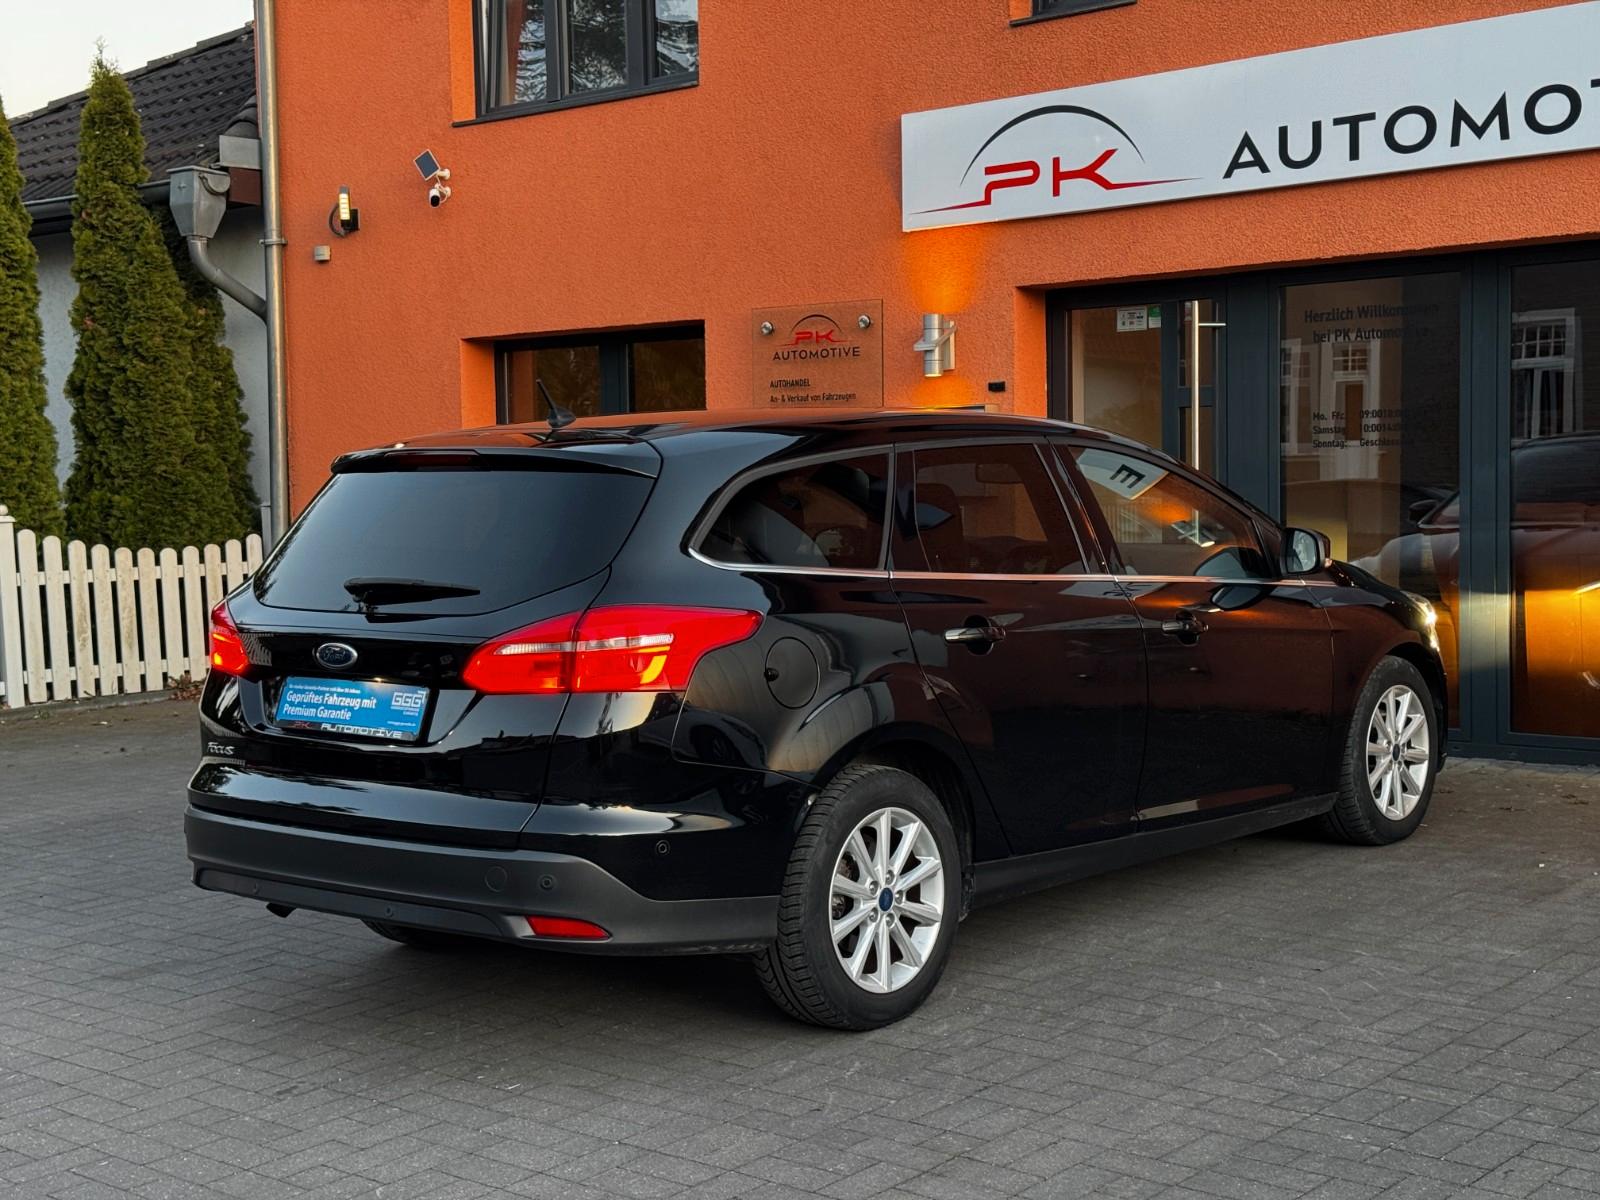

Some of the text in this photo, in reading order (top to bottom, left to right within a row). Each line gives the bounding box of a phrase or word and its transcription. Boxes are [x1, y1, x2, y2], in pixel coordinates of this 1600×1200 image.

[1304, 303, 1439, 323] Herzlich Willkom
[793, 329, 836, 346] PK
[1312, 330, 1331, 343] bei
[1334, 328, 1351, 342] PK
[772, 346, 861, 361] AUTOMOTIVE
[769, 378, 811, 389] AUTOHANDEL
[822, 392, 857, 403] Fahrzeugen
[286, 690, 323, 705] Geprüftes
[323, 693, 362, 711] Fahrzeug
[361, 697, 377, 709] mit
[283, 703, 352, 721] Premium Garantie
[320, 723, 402, 738] AUTOMOTIVE
